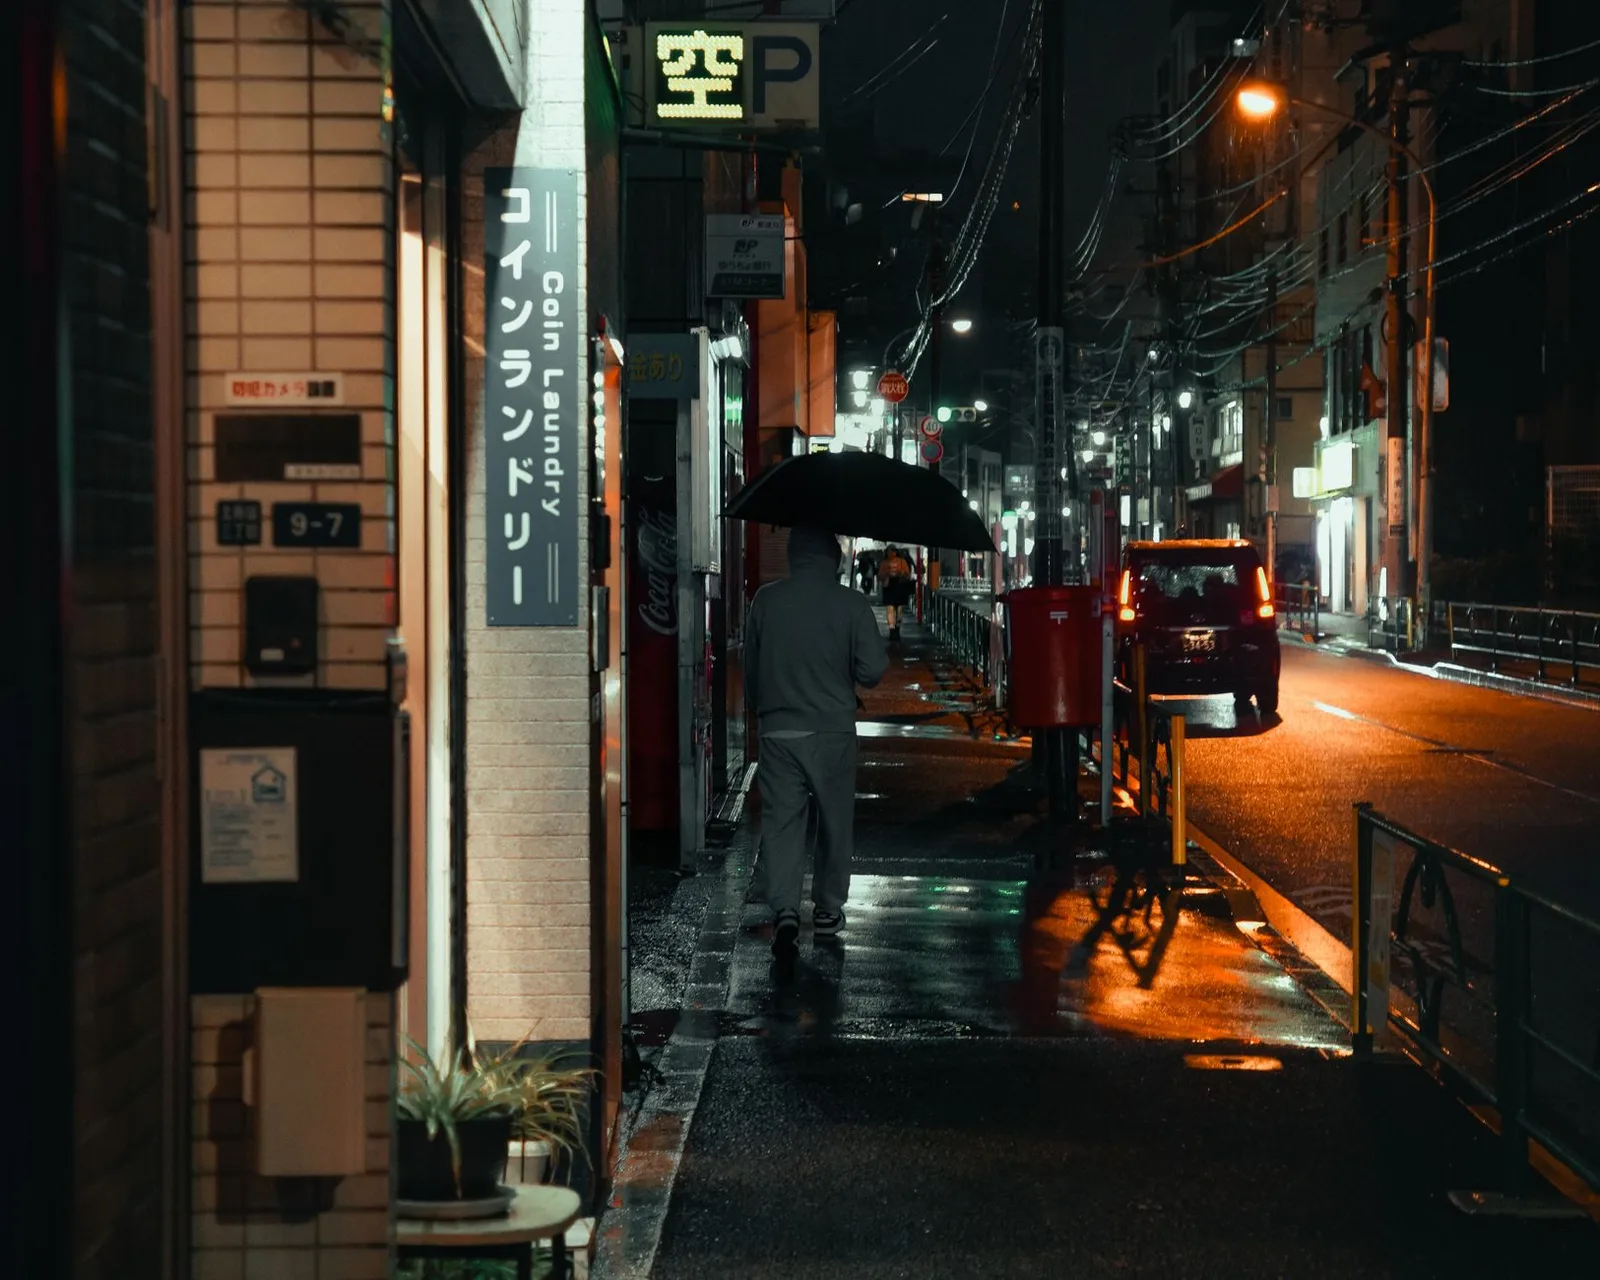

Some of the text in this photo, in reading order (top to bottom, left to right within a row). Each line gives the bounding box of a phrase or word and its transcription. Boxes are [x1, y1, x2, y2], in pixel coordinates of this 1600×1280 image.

[656, 29, 812, 119] 空 P
[500, 187, 533, 606] コインランドリー
[542, 271, 564, 517] Coin Laundry
[290, 511, 344, 538] 9-7
